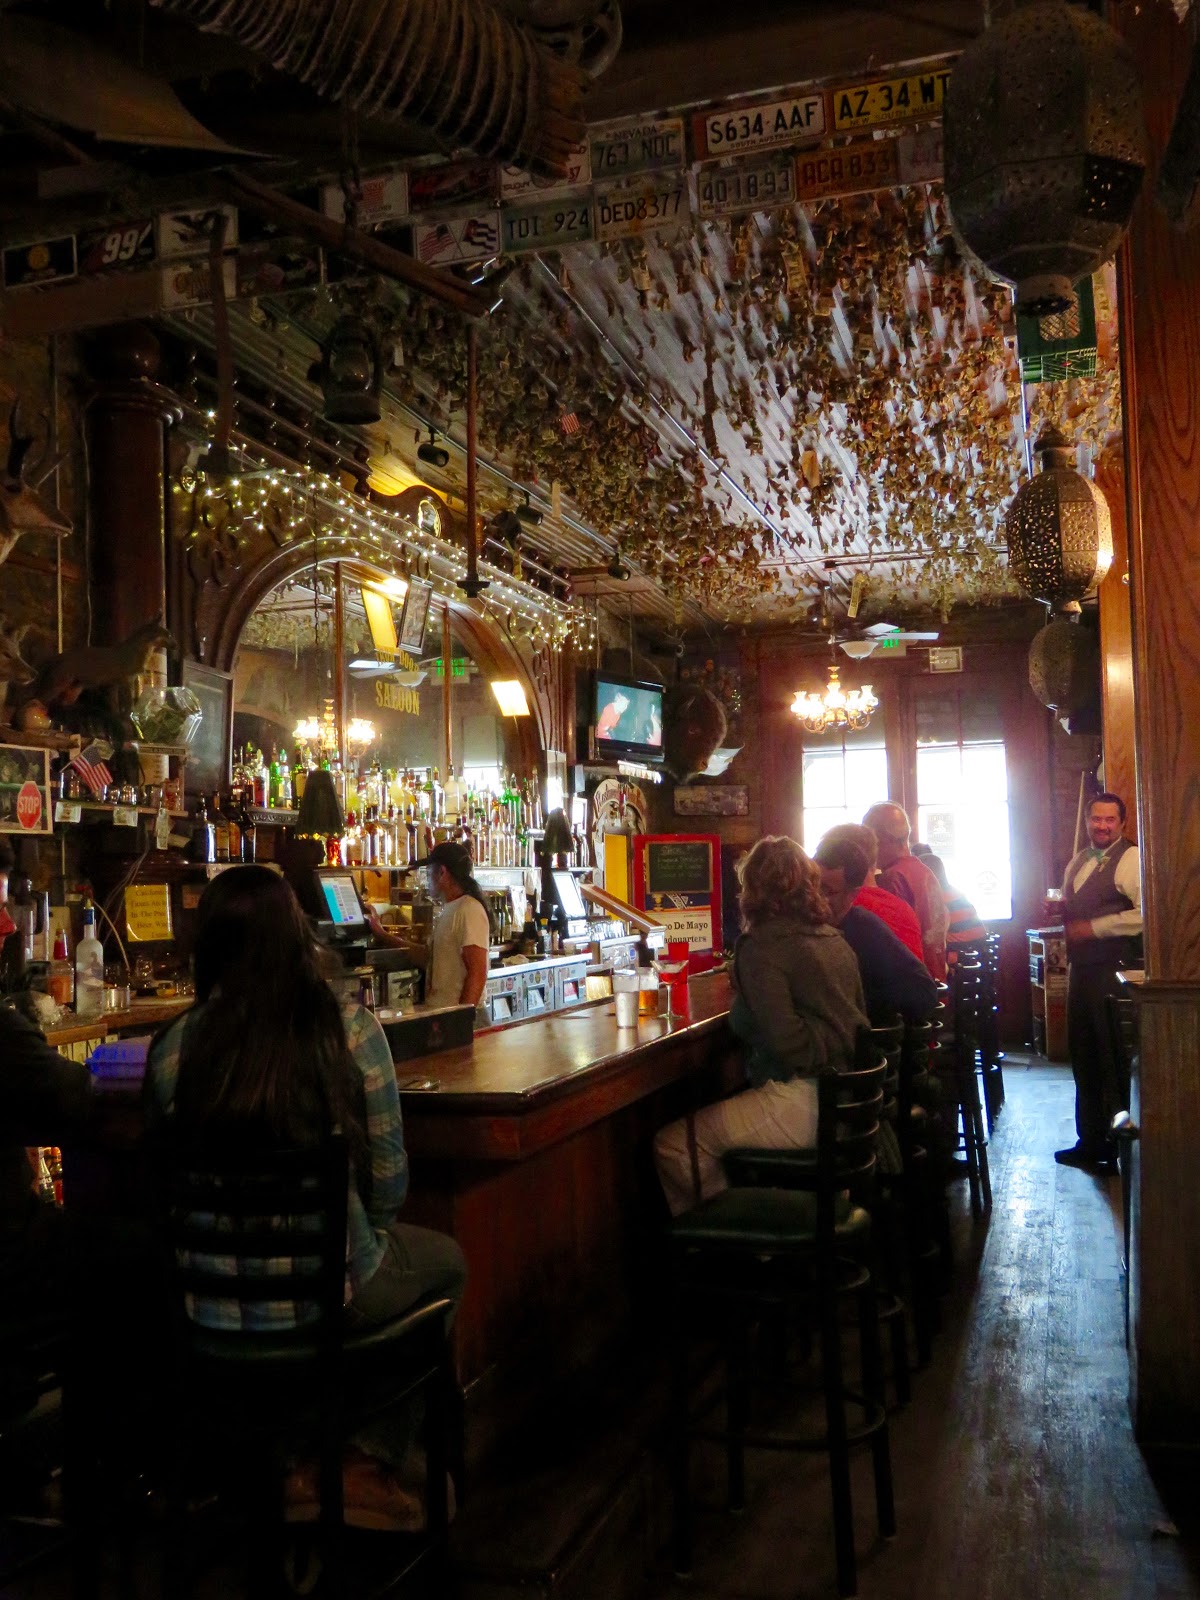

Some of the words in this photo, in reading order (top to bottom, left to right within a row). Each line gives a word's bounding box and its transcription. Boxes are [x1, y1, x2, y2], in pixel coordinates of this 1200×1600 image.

[759, 129, 801, 143] AUSTRALIA
[554, 208, 589, 233] 924
[375, 680, 420, 716] SALOON
[19, 795, 40, 815] STOP
[673, 921, 685, 930] De
[686, 921, 708, 931] Mayo
